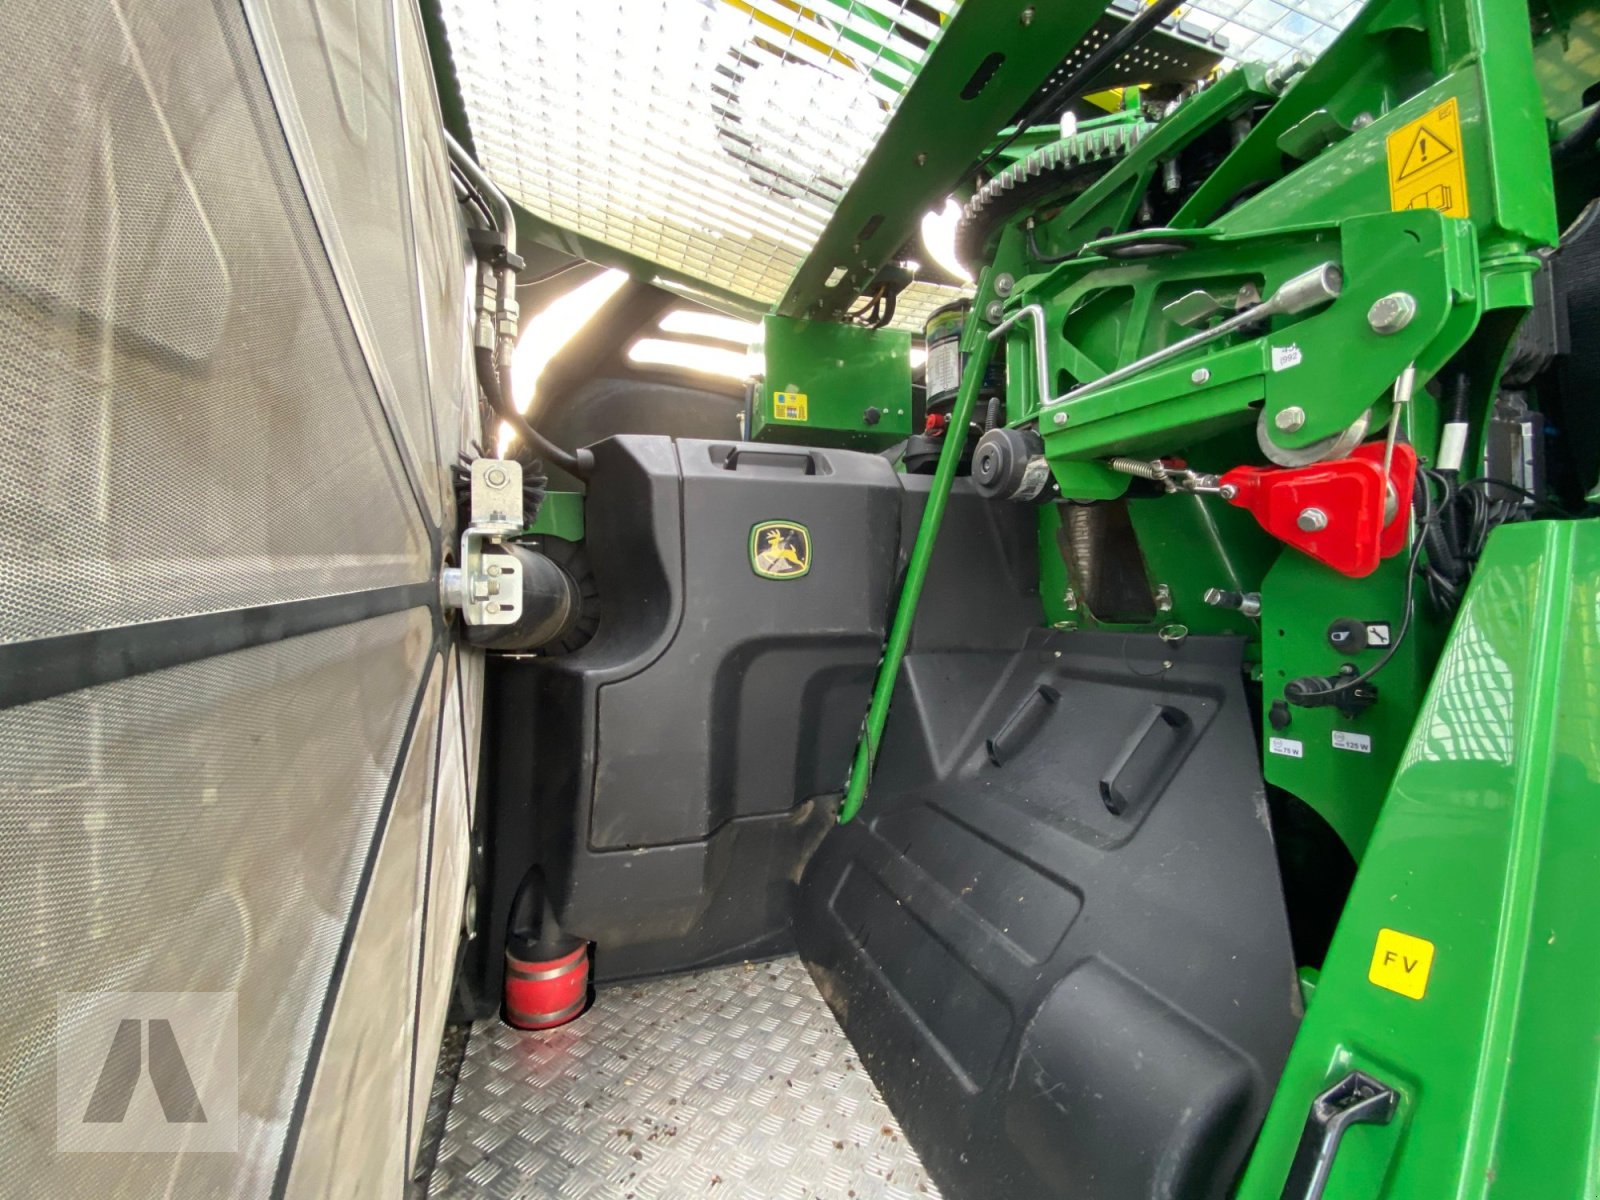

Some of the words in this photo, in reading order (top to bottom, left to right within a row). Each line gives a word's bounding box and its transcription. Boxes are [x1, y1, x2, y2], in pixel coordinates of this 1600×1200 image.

[1346, 741, 1359, 750] 125
[1360, 743, 1369, 751] W
[1292, 748, 1299, 756] W
